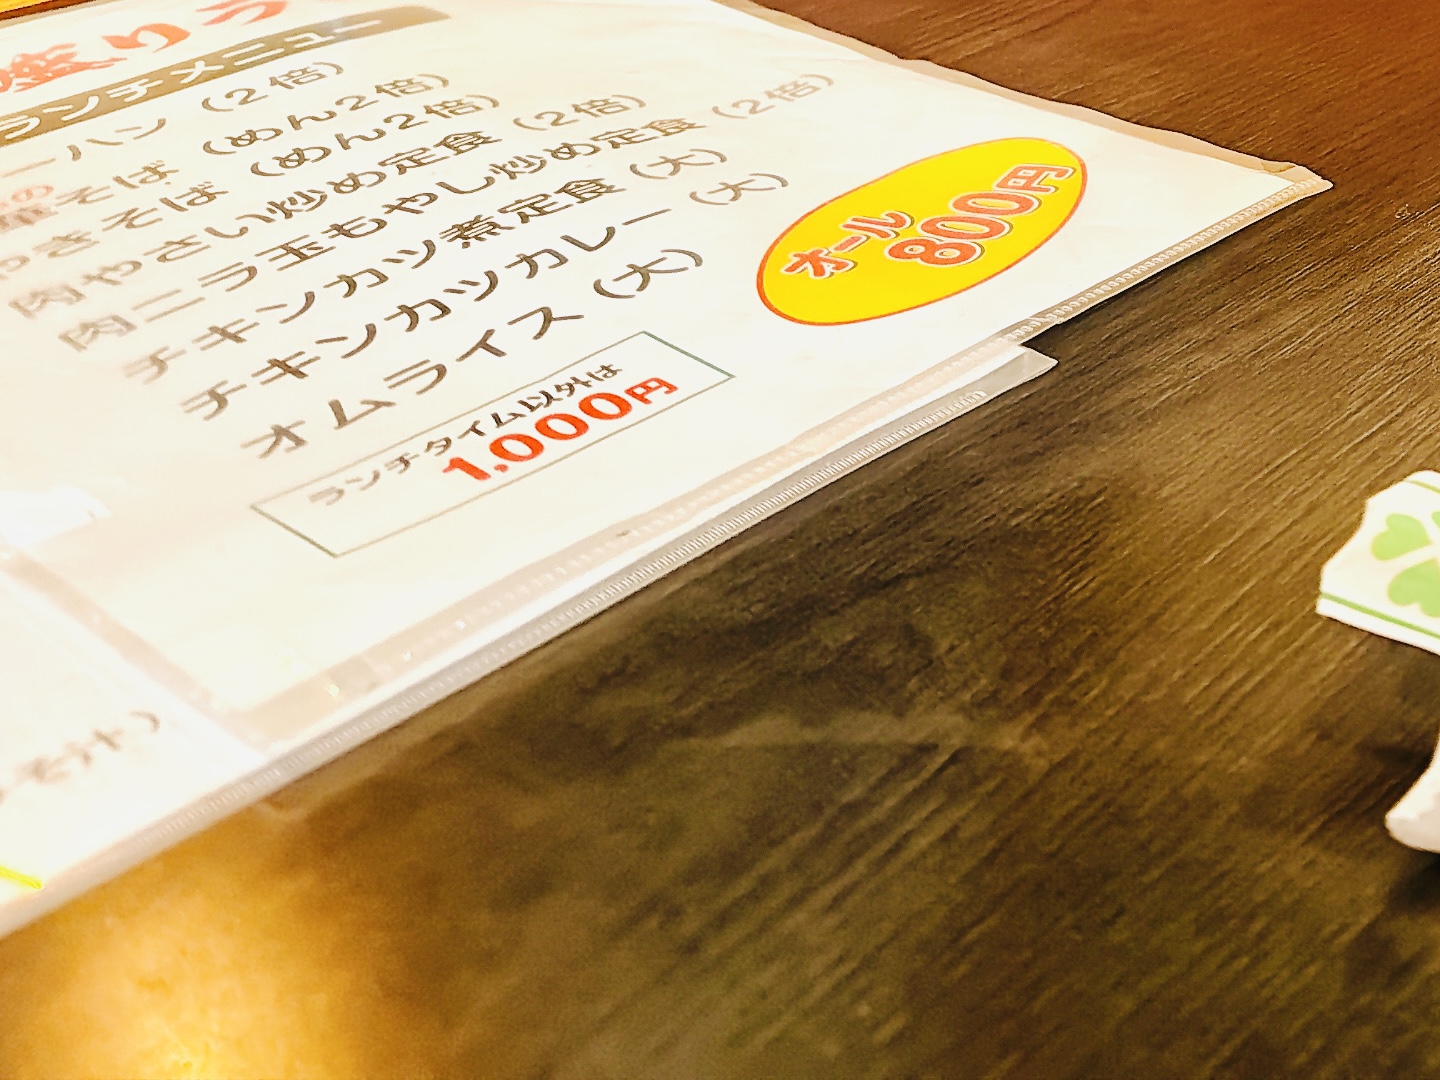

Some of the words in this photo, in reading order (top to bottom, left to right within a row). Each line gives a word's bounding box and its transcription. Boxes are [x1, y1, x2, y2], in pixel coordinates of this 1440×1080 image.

[781, 209, 915, 280] オール
[884, 164, 1078, 267] 800円
[309, 363, 623, 508] ランチタイム以外は
